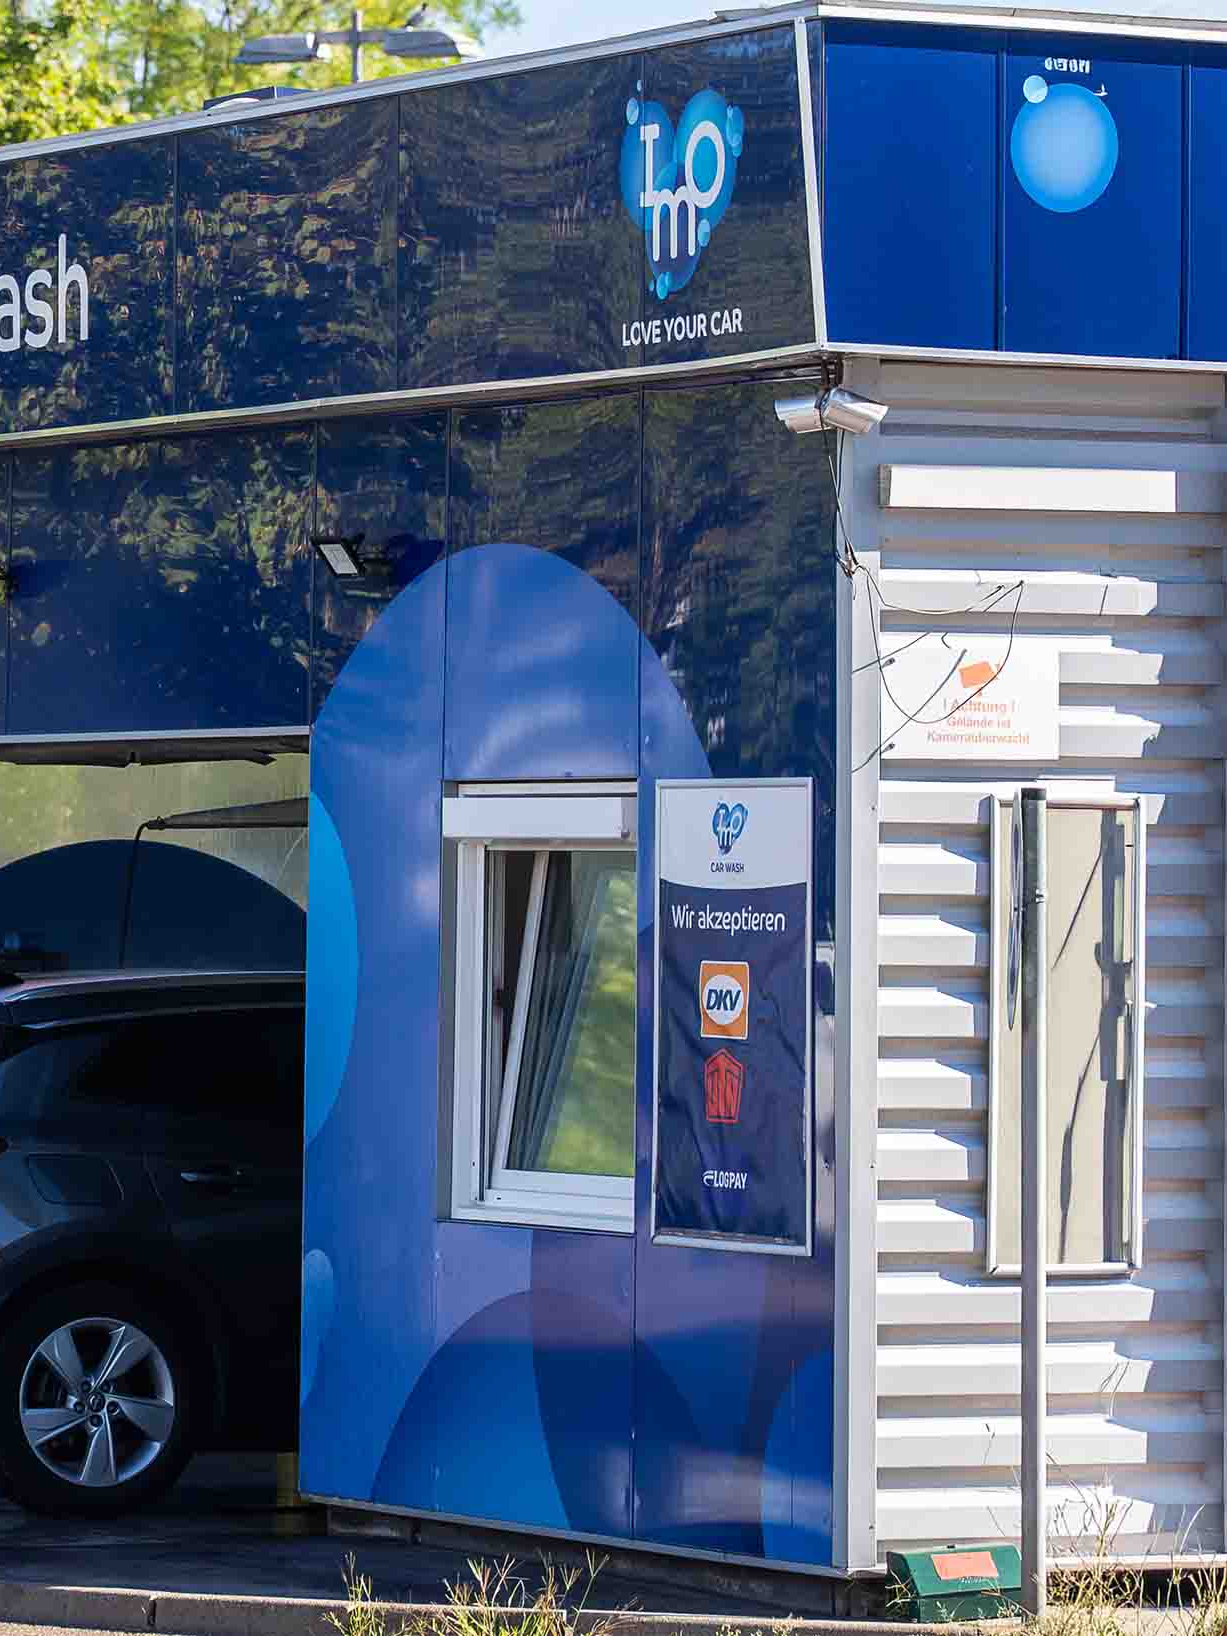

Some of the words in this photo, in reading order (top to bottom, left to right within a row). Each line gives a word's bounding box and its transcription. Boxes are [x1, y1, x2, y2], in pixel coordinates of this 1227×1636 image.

[622, 320, 661, 346] LOVE
[663, 313, 707, 342] YOUR
[710, 307, 743, 336] CAR
[710, 862, 724, 873] CAR
[725, 863, 745, 873] WASH
[672, 904, 694, 929] Wir
[698, 904, 785, 936] akzeptieren
[706, 989, 740, 1012] DKV
[713, 1171, 747, 1190] LOGPAY
